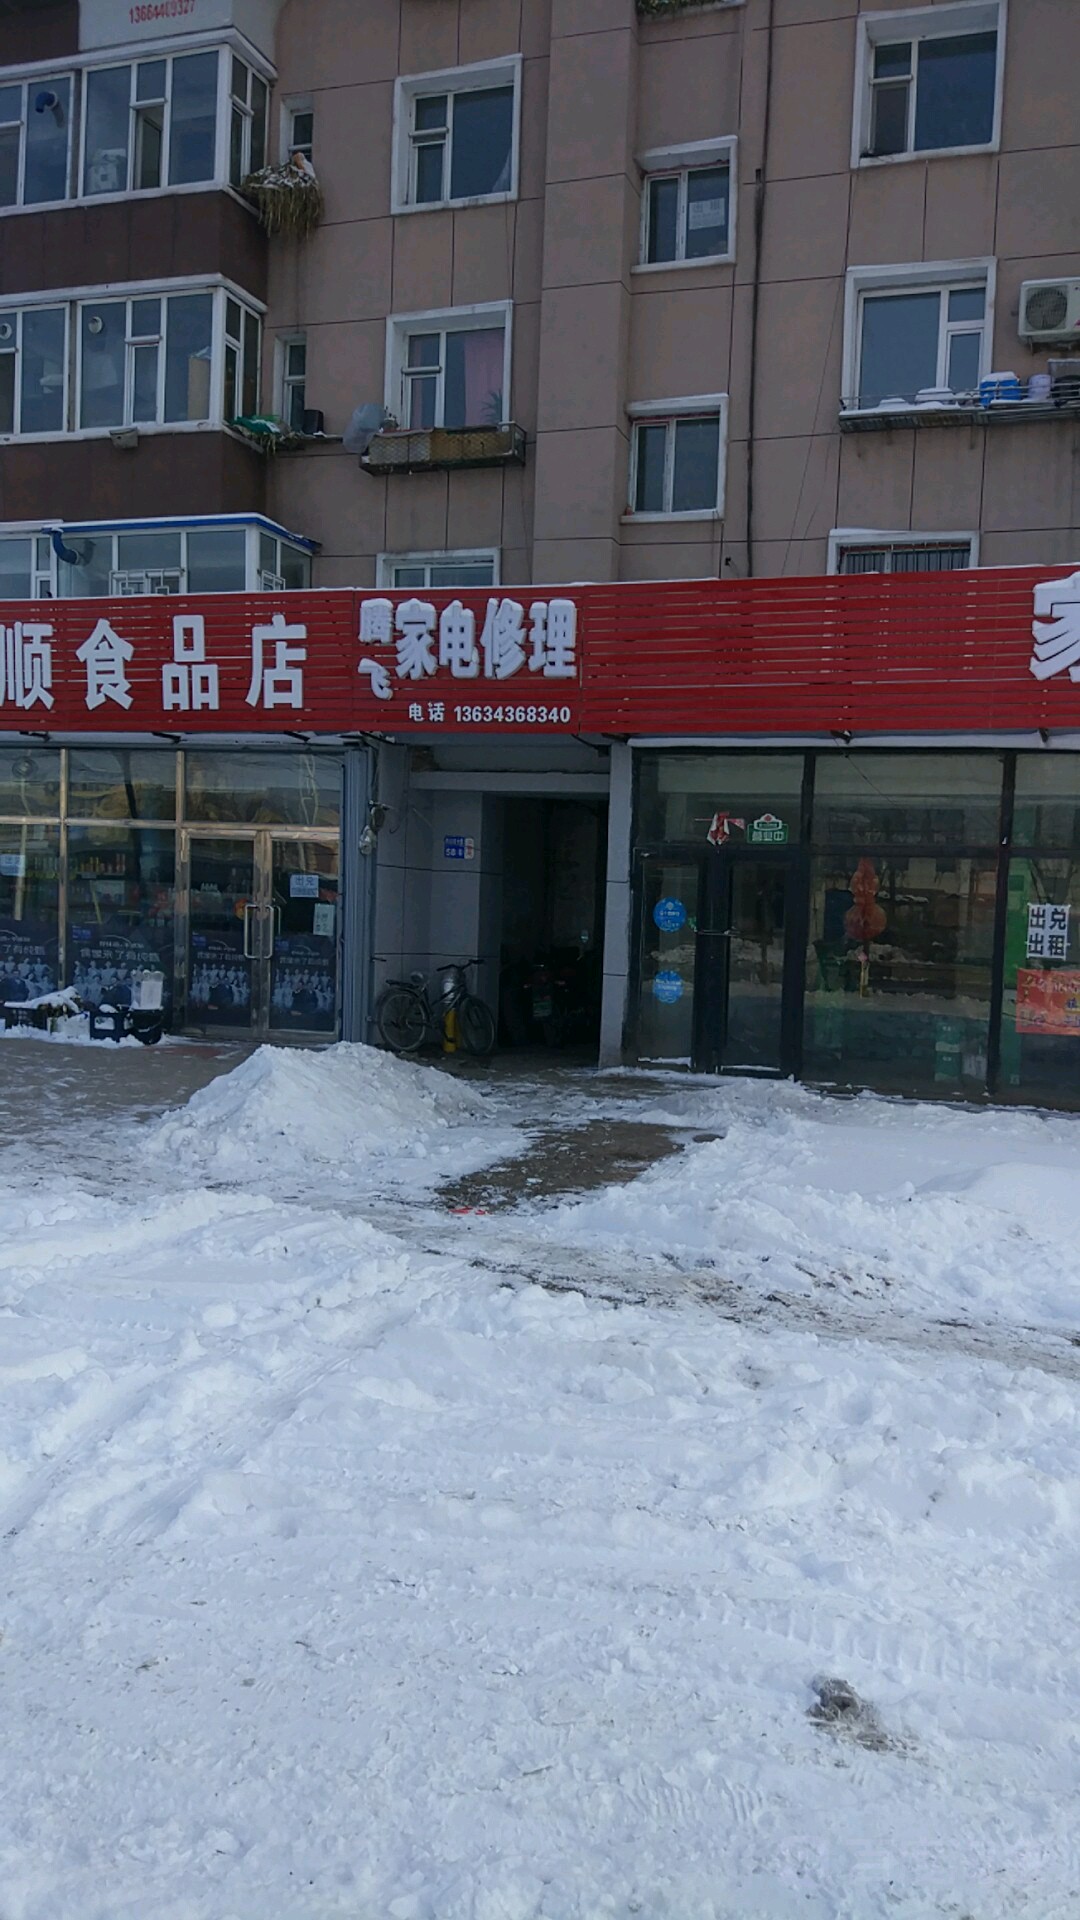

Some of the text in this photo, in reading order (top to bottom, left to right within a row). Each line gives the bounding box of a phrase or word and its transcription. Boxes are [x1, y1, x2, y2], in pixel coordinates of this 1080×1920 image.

[395, 597, 578, 681] 家电修理
[0, 613, 308, 711] 顺食品店
[408, 702, 571, 723] 电话 13634368340
[1030, 908, 1067, 931] 出兑
[1028, 932, 1065, 956] 出租
